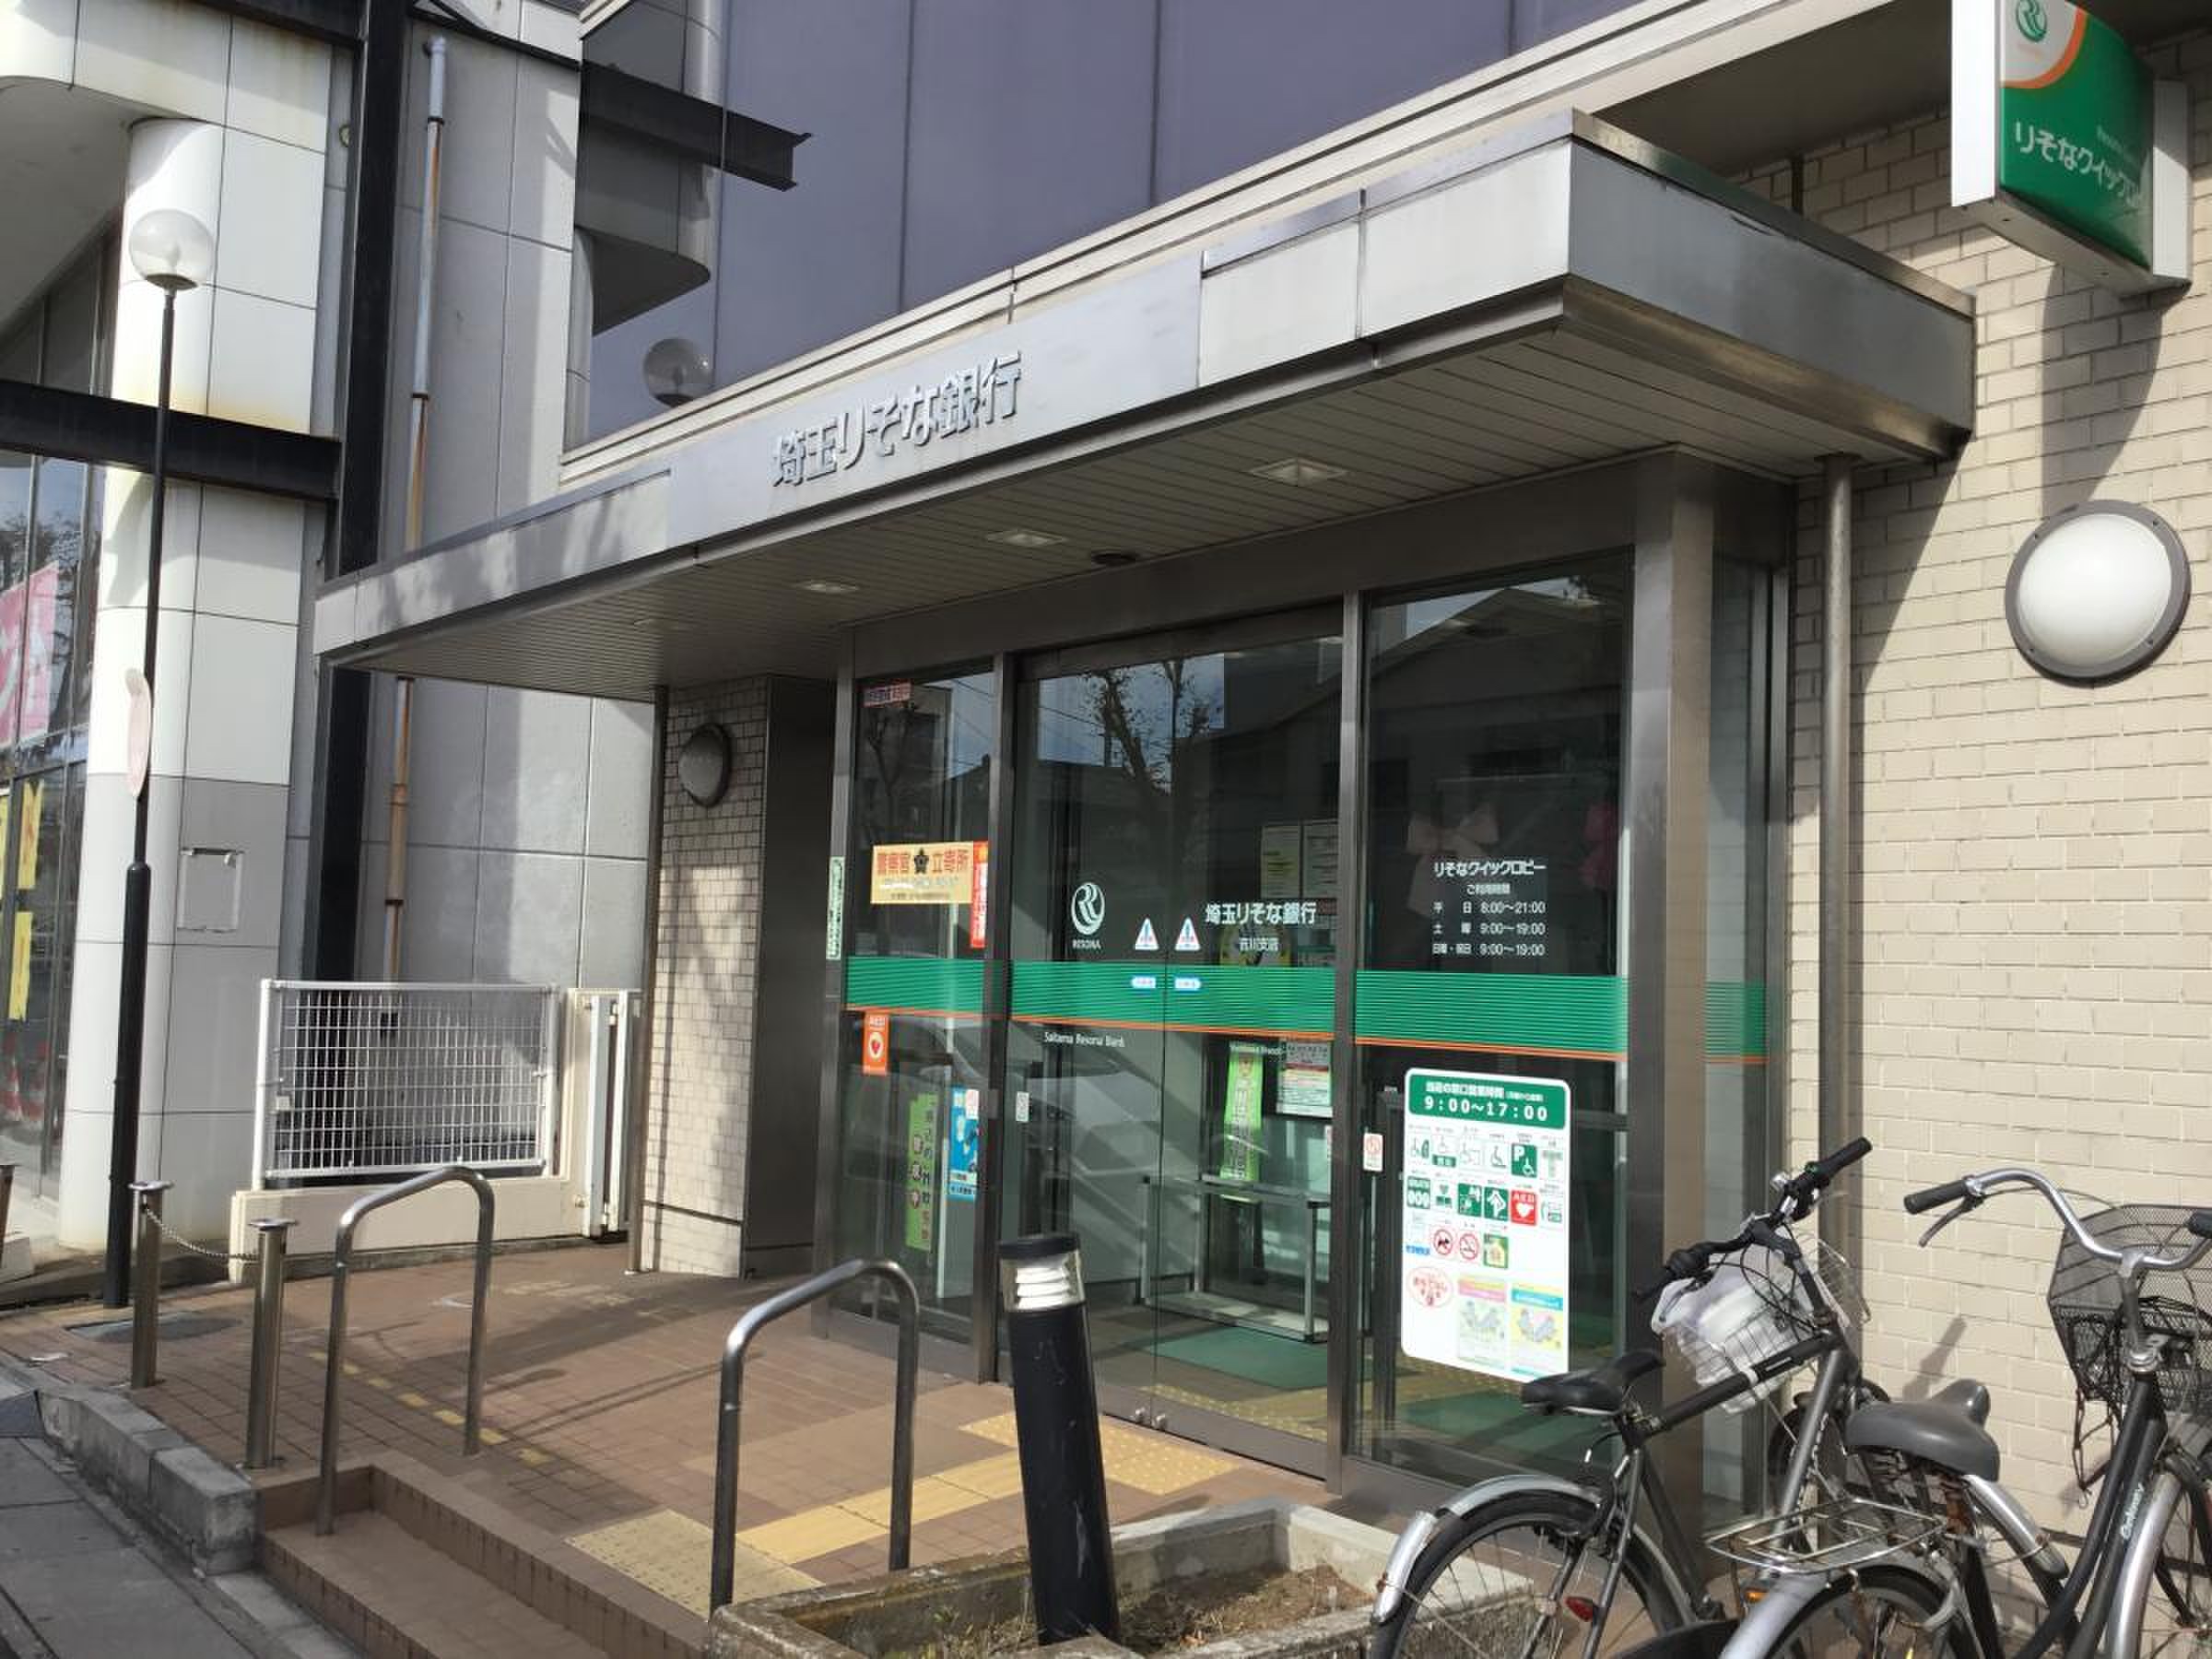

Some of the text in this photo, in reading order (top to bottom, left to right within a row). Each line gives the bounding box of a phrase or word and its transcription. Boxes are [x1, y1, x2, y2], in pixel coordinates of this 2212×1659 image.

[771, 350, 1021, 488] 埼玉りそな銀行
[1433, 860, 1547, 877] りそなクイックロビー
[1205, 902, 1317, 925] 埼玉りそな銀行
[1044, 1031, 1125, 1048] Saitama Resona Bank
[1424, 1095, 1548, 1122] 9:00～17:00
